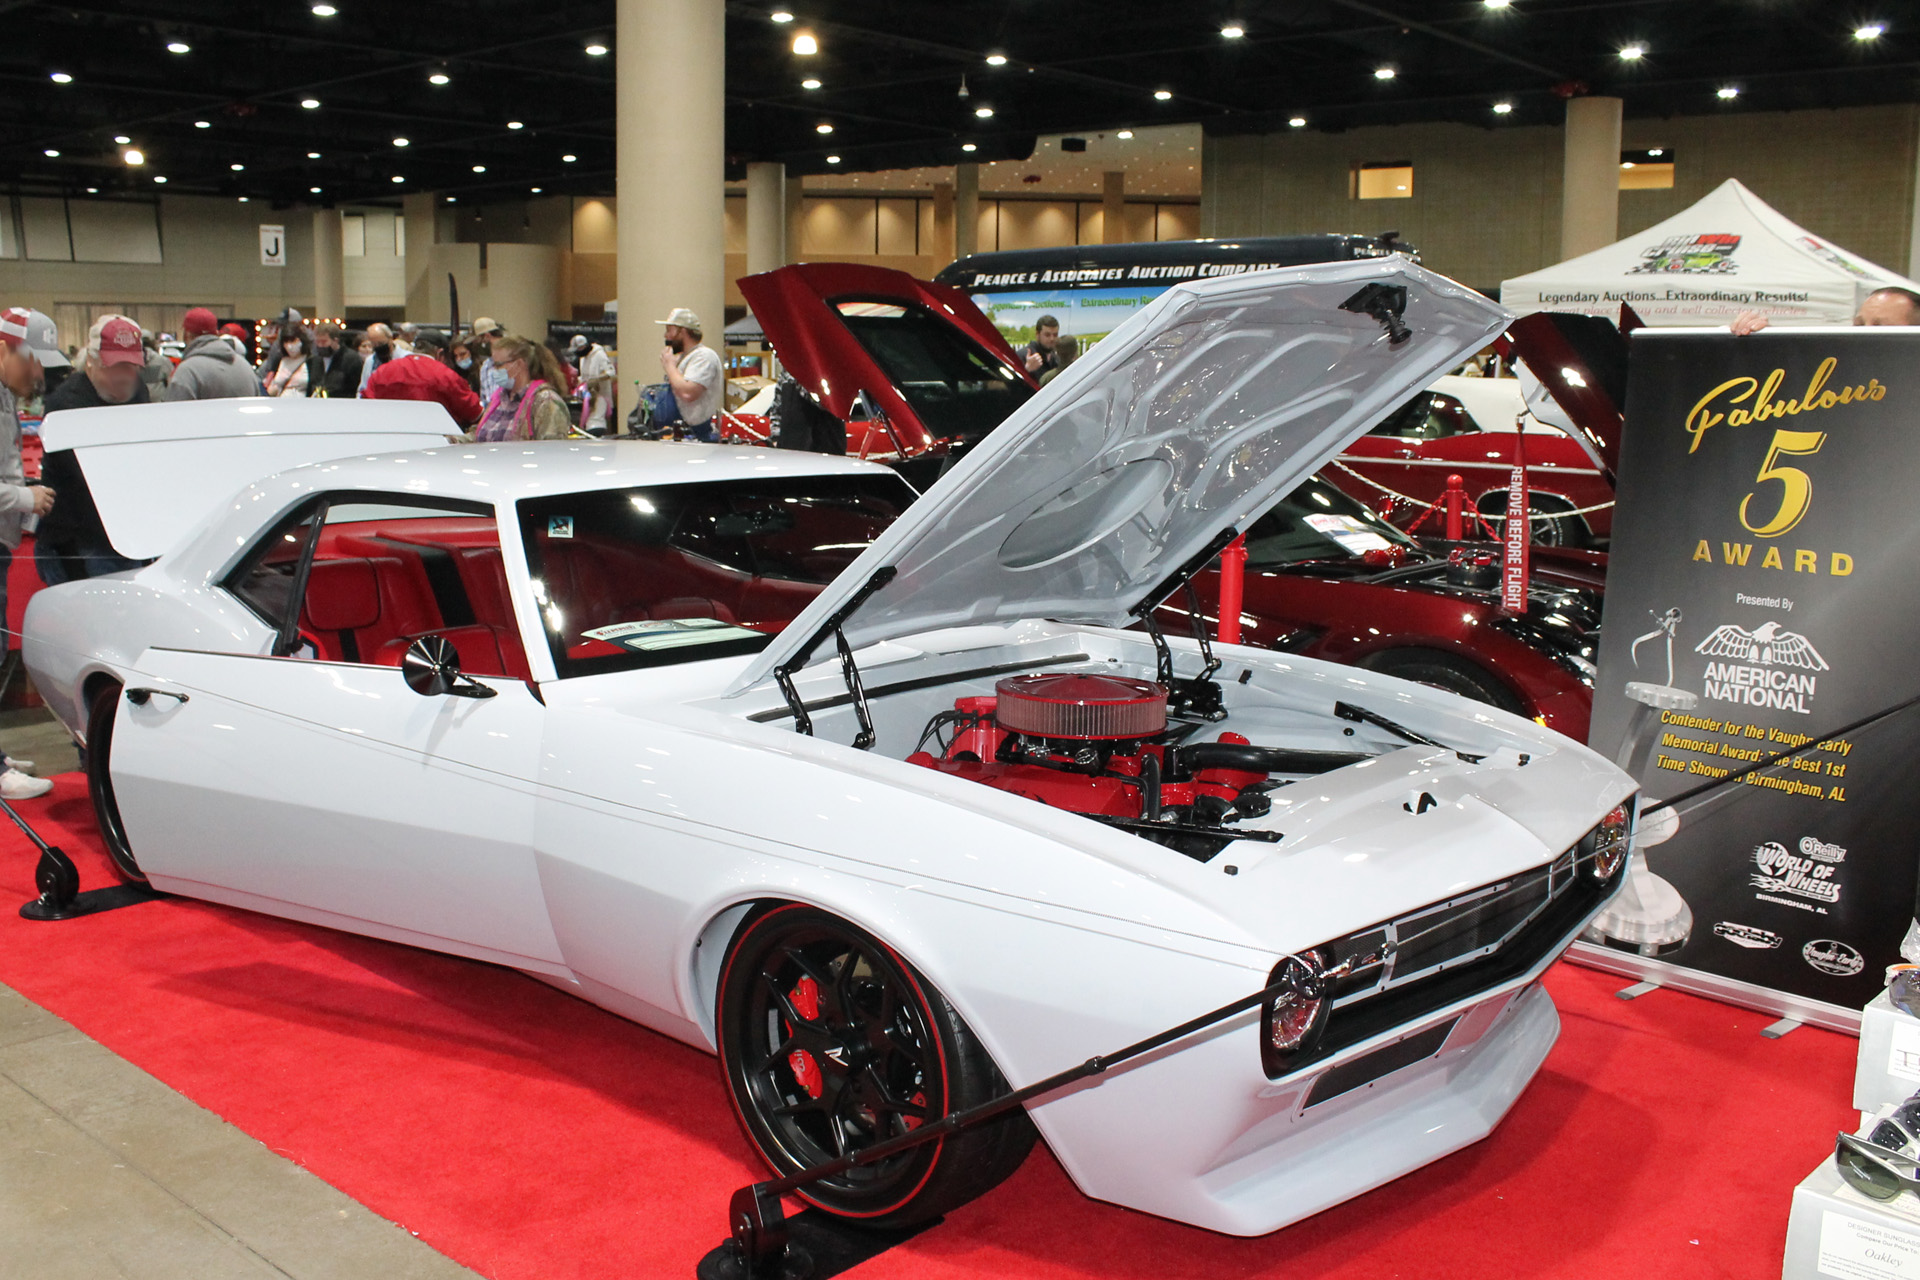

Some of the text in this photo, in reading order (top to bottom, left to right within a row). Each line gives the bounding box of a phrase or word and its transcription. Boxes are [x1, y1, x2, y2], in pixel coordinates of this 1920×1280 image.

[265, 236, 279, 257] J
[973, 271, 1026, 288] PEARCE
[1040, 268, 1125, 284] ASSOCIATES
[1128, 264, 1196, 280] AUCTION
[1539, 291, 1600, 304] Legendary
[1755, 290, 1808, 303] Results!
[1655, 305, 1678, 315] and
[1681, 305, 1702, 315] sell
[1685, 356, 1887, 454] Fabulous
[1739, 429, 1828, 538] 5
[1507, 465, 1524, 609] REMOVE BEFORE FLIGHT
[1692, 539, 1855, 578] AWARD
[1736, 593, 1793, 611] Presented By
[1703, 661, 1816, 695] AMERICAN
[1704, 680, 1811, 714] NATIONAL
[1660, 710, 1722, 732] Contender
[1723, 720, 1742, 736] for
[1744, 724, 1765, 740] the
[1661, 732, 1719, 755] Memorial
[1719, 743, 1764, 764] Award:
[1792, 755, 1822, 774] Best
[1825, 762, 1847, 778] 1st
[1656, 754, 1687, 773] Time
[1688, 760, 1729, 779] Shown
[1745, 771, 1825, 801] Birmingham,
[1828, 787, 1847, 802] AL
[1761, 847, 1836, 880] WORLD OF
[1801, 837, 1846, 862] O'Reilly
[1785, 870, 1841, 902] WHEELS
[1755, 893, 1815, 913] BIRMINGHAM,
[1816, 907, 1828, 915] AL
[1847, 1222, 1882, 1237] DESIGNER
[1856, 1232, 1881, 1244] Compare
[1864, 1248, 1903, 1268] Oakley
